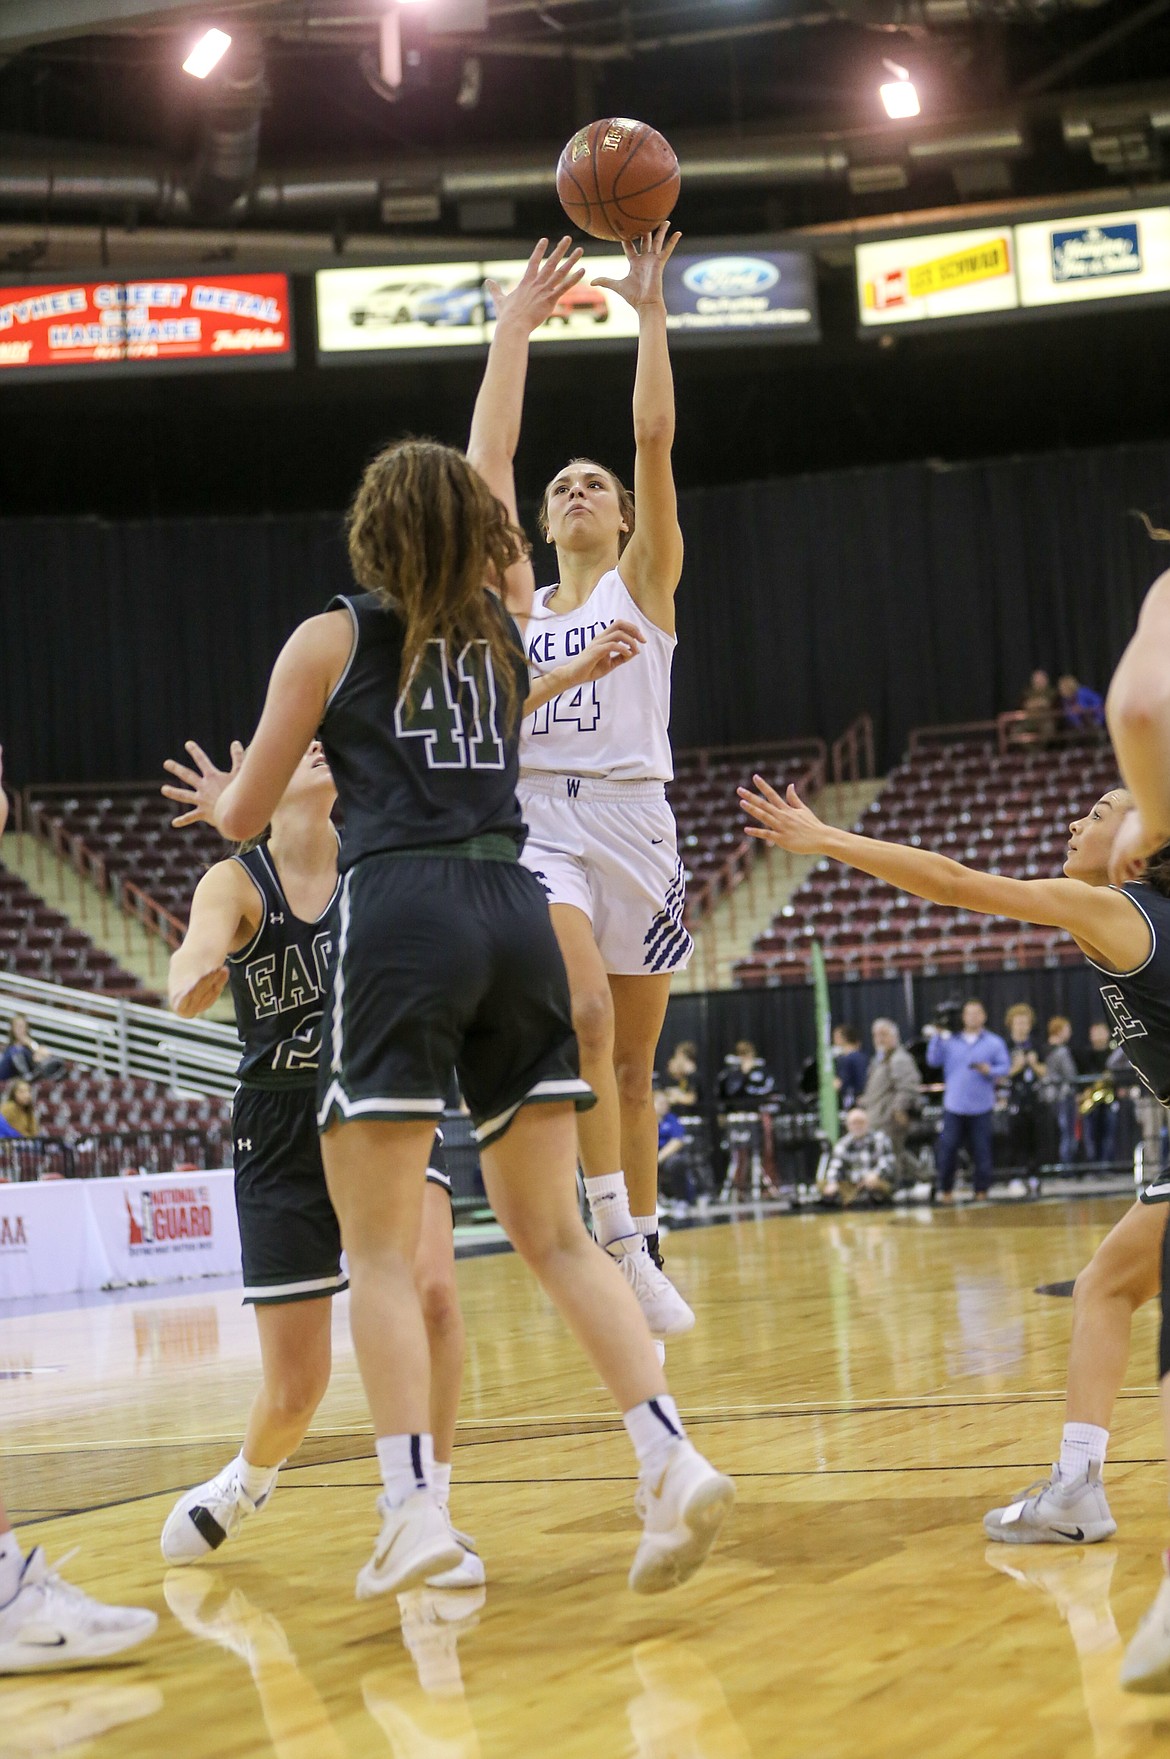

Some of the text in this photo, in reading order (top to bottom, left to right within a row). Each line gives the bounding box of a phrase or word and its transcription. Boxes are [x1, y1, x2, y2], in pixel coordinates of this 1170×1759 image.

[93, 284, 187, 308] SHEET
[191, 285, 281, 323] METAL
[48, 318, 201, 348] HARDWARE
[529, 634, 556, 663] KE
[394, 638, 505, 769] 41
[566, 778, 580, 799] W
[154, 1205, 212, 1241] GUARD
